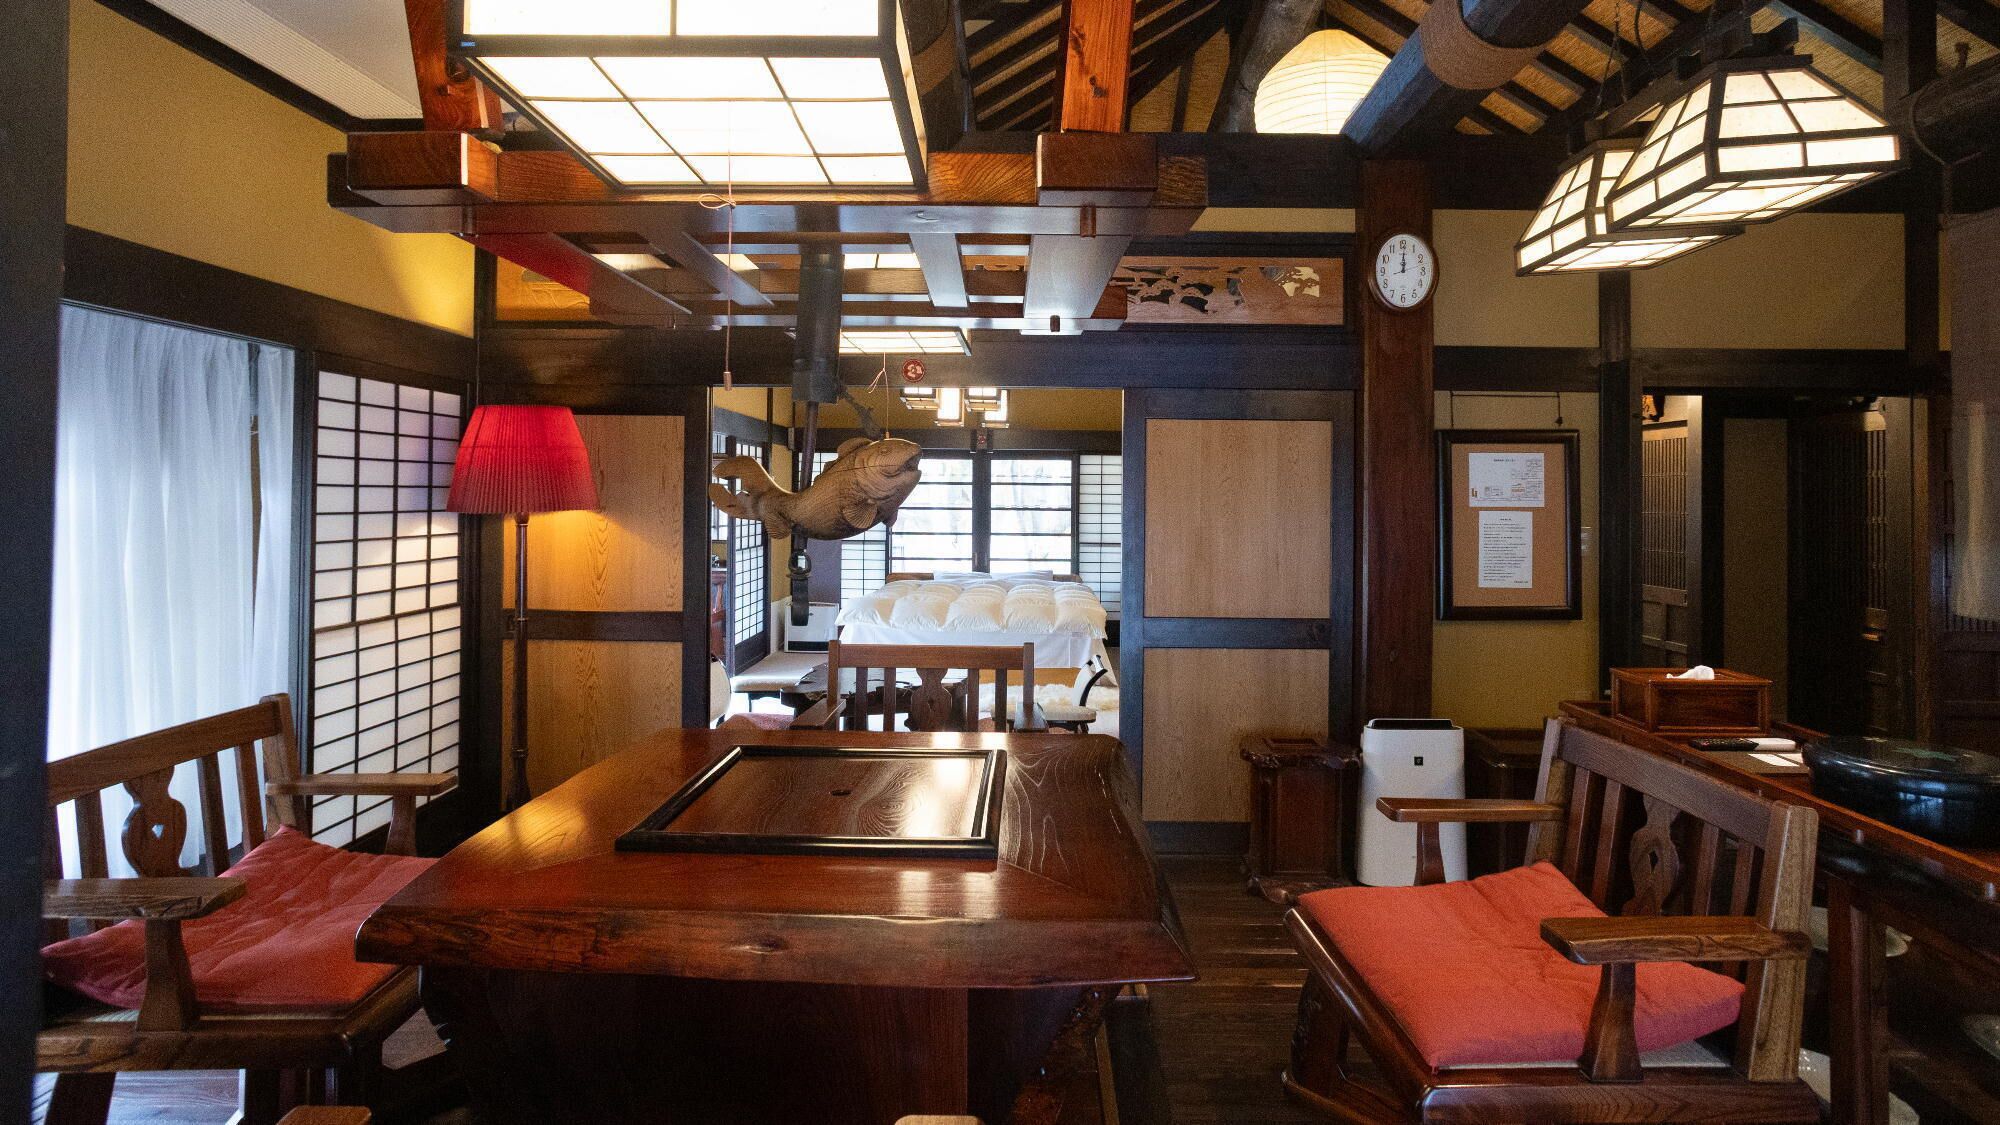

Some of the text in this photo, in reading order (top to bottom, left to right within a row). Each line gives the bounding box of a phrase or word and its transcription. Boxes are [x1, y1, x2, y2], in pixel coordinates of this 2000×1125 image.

[1389, 244, 1395, 253] 11
[1399, 239, 1407, 250] 12
[1382, 254, 1389, 264] 10
[1417, 254, 1423, 263] 2
[1380, 267, 1385, 276] 9
[1420, 267, 1426, 276] 3
[1383, 279, 1388, 288] 8
[1418, 279, 1422, 288] 4
[1390, 290, 1395, 298] 7
[1412, 289, 1417, 298] 5
[1400, 294, 1406, 303] 6
